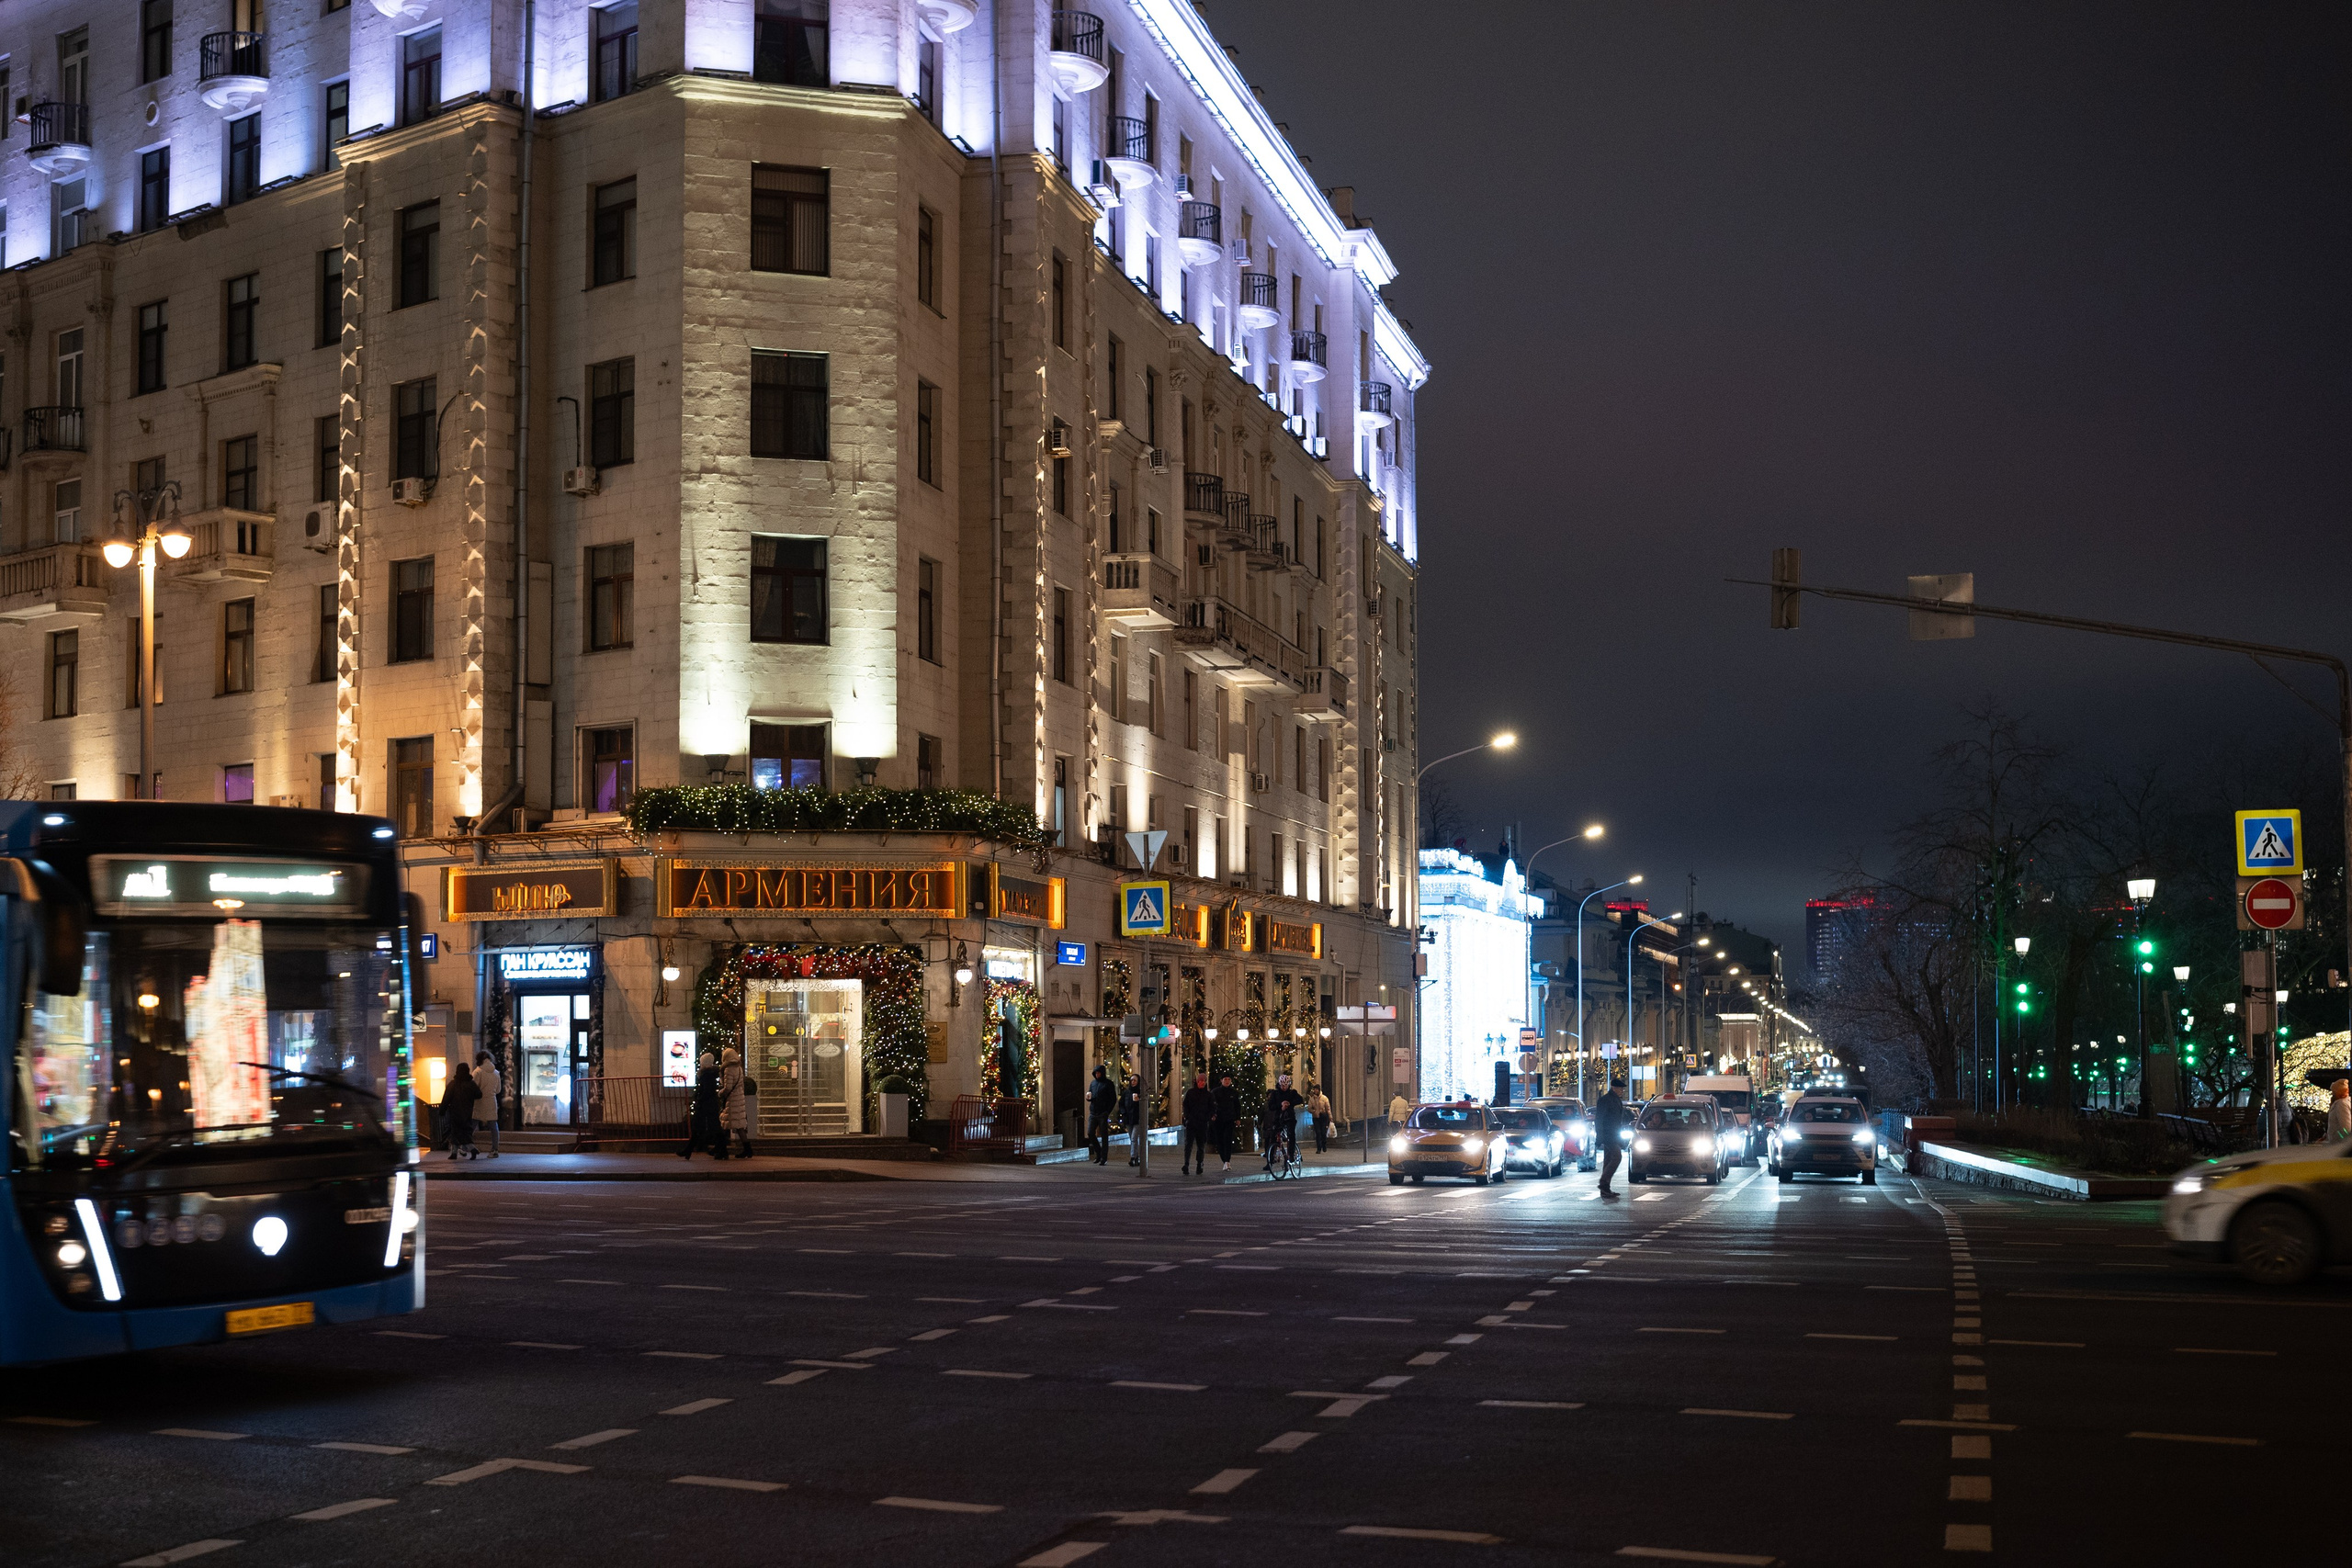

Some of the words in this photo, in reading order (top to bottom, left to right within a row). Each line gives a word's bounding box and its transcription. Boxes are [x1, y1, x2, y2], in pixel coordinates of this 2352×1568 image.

[689, 869, 938, 908] АРМЕНИЯ
[501, 953, 526, 970] ПАН
[528, 952, 590, 969] КРУАССАН
